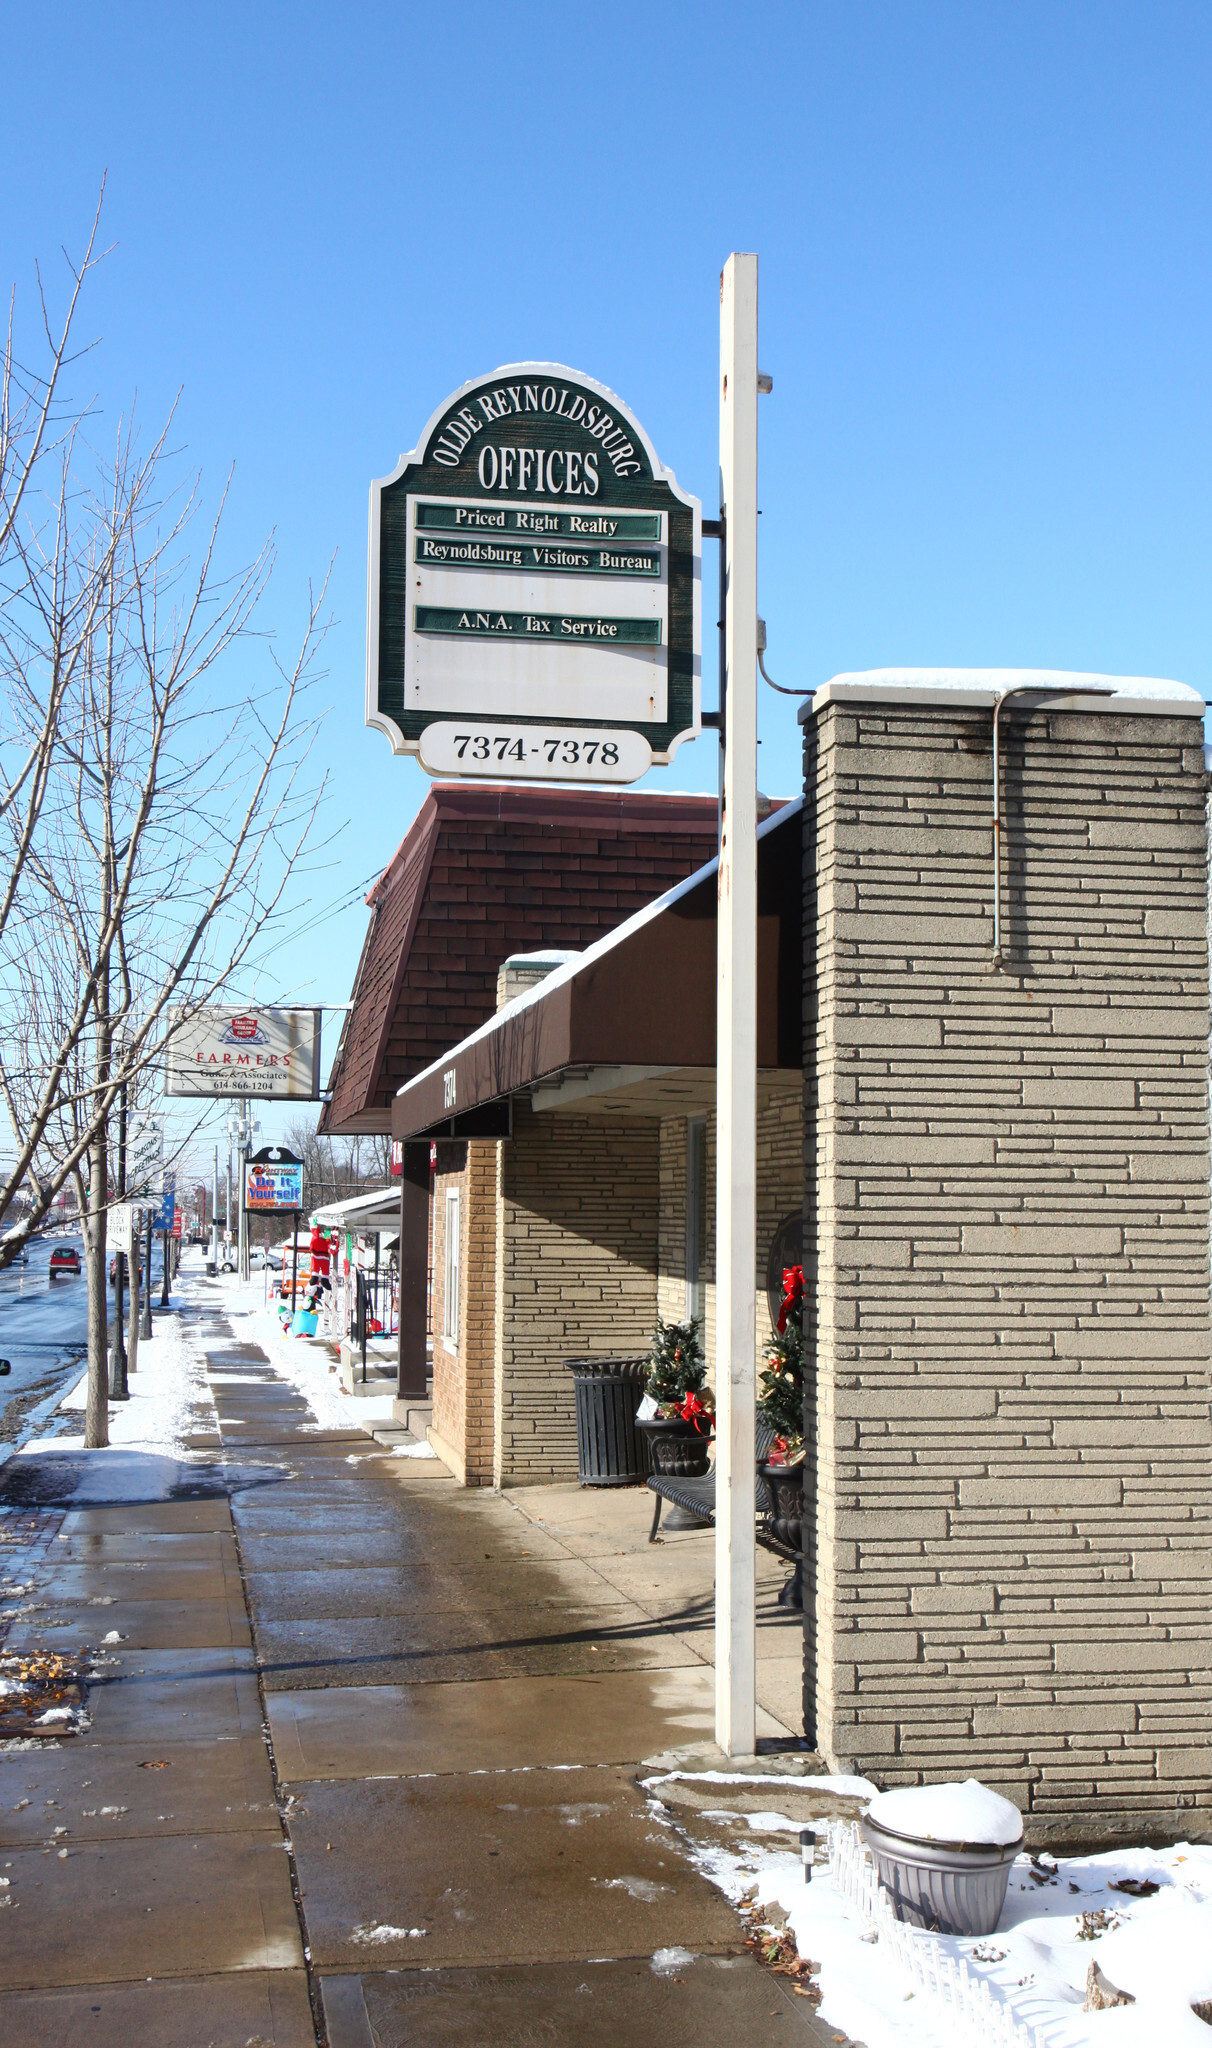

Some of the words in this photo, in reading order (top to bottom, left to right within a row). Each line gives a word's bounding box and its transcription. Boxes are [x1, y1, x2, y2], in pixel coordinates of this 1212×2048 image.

[432, 408, 484, 467] OLDE
[476, 385, 642, 478] REYNOLDSBURG
[478, 445, 600, 496] OFFICES
[455, 508, 506, 527] Priced
[516, 512, 559, 532] Right
[570, 516, 619, 536] Realty
[423, 540, 522, 565] Reynoldsburg
[532, 547, 589, 567] Visitors
[599, 553, 652, 570] Bureau
[458, 612, 513, 630] A.N.A.
[522, 616, 551, 633] Tax
[561, 618, 618, 637] Service
[453, 735, 620, 766] 7374-7378
[197, 1052, 291, 1066] FARMERS
[213, 1081, 273, 1090] 614-866-1204
[240, 1071, 287, 1080] Associates
[443, 1068, 456, 1109] 7374
[249, 1187, 300, 1200] Yourself
[256, 1177, 275, 1187] Do
[281, 1177, 293, 1187] It
